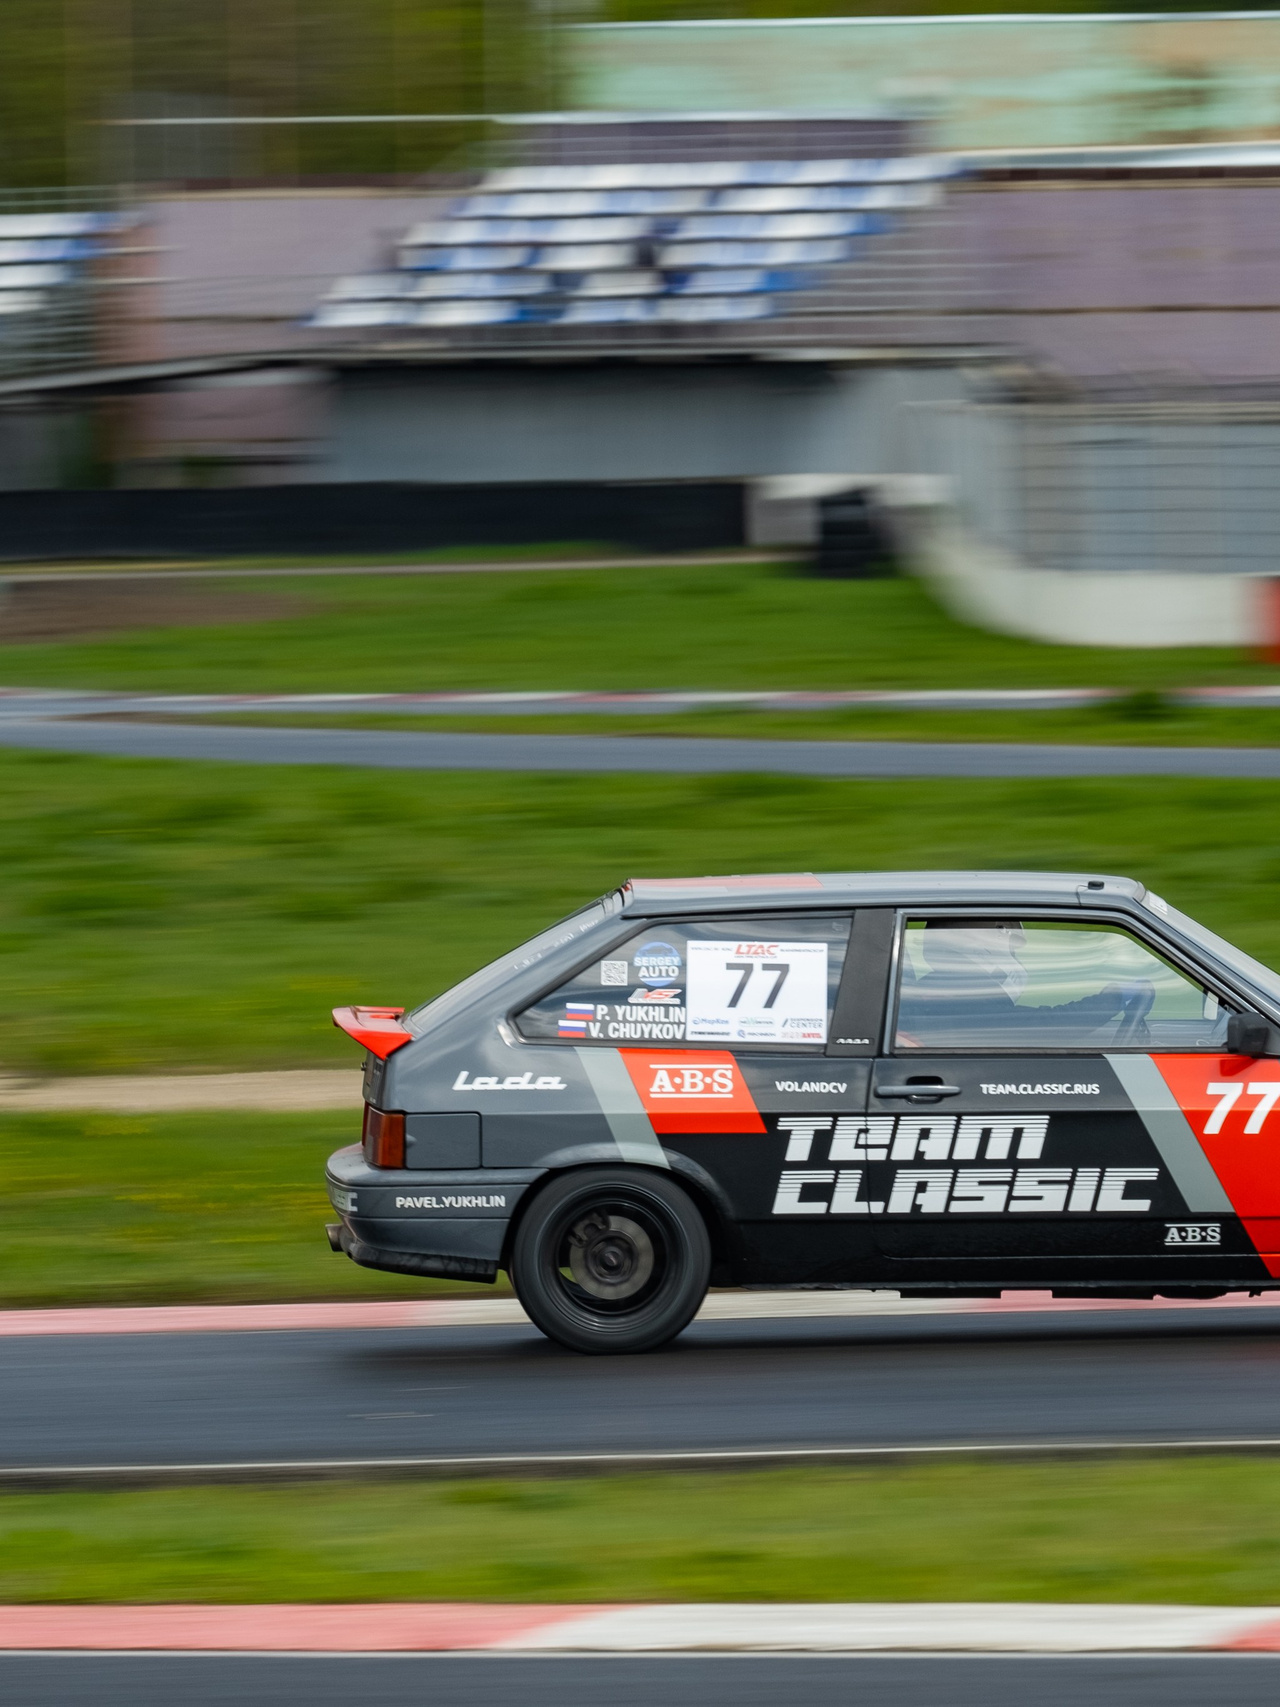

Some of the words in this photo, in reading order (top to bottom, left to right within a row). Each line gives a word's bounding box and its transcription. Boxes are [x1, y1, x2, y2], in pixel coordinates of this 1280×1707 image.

[735, 944, 779, 955] LTAC
[634, 956, 681, 966] SERGEY
[638, 966, 679, 977] AUTO
[725, 962, 790, 1009] 77
[596, 1004, 610, 1020] P.
[614, 1005, 686, 1022] YUKHLIN
[589, 1022, 604, 1038] V.
[607, 1022, 686, 1039] CHUYKOV
[452, 1071, 567, 1091] Lada
[775, 1081, 848, 1093] VOLANDCV
[980, 1083, 1100, 1096] TEAM.CLASSIC.RUS
[777, 1115, 1051, 1161] TEAM
[772, 1168, 1160, 1214] CLASSIC
[395, 1195, 506, 1209] PAVEL.YUKHLIN
